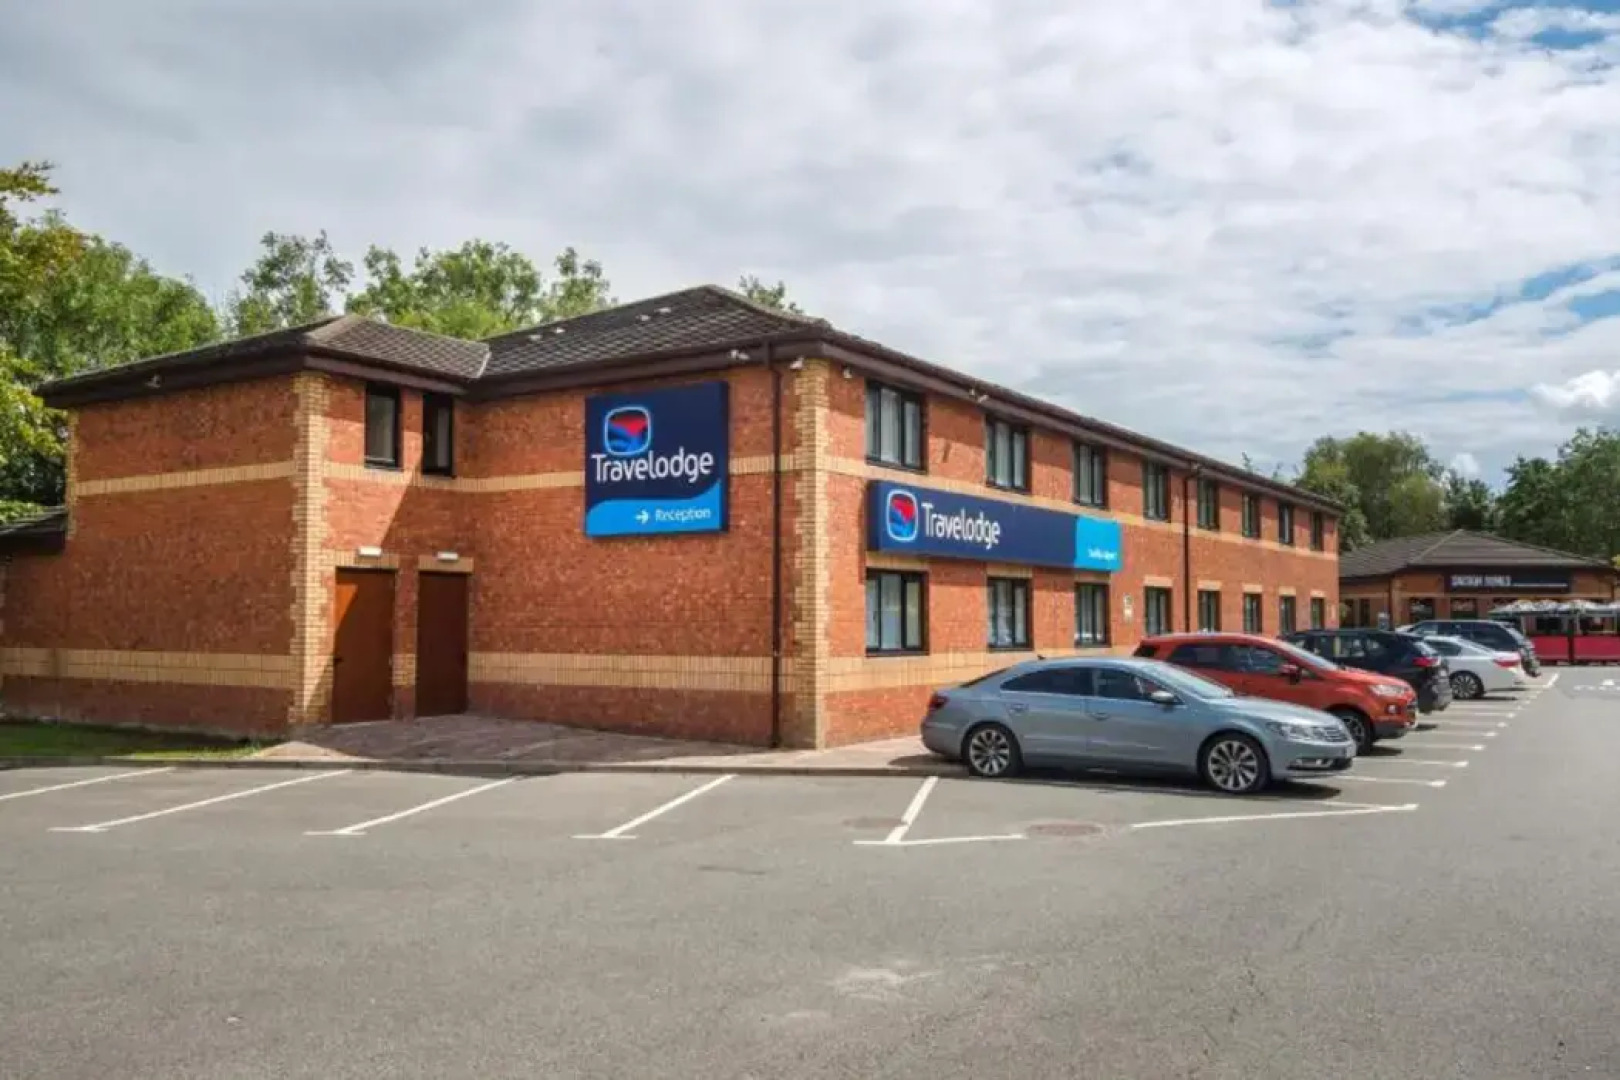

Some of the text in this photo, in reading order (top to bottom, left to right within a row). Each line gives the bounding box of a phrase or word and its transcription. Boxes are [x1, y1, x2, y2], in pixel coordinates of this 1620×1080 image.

[591, 447, 714, 483] Travelodge
[655, 508, 711, 523] Reception
[921, 503, 1000, 549] Travelodge
